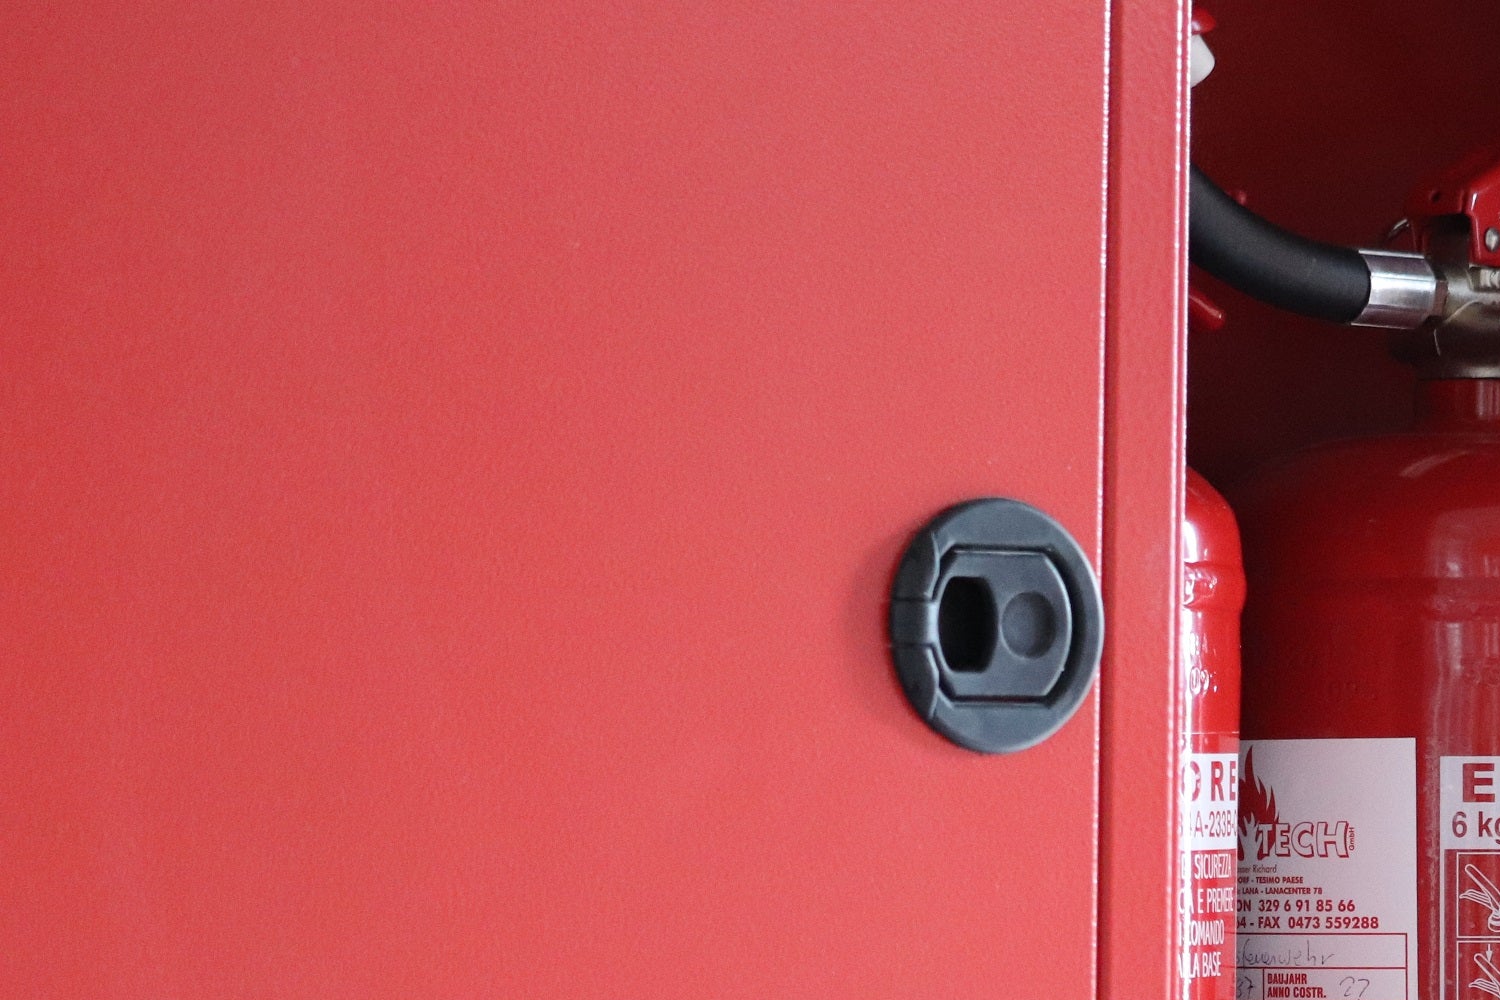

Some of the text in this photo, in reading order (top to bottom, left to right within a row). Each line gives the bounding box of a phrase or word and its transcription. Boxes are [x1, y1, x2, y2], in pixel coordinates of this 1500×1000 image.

[1452, 812, 1467, 837] 6
[1253, 865, 1277, 873] Richard
[1258, 900, 1355, 911] 329 6 91 85 66
[1258, 917, 1378, 928] FAX 0473 559288
[1203, 952, 1221, 977] BASE
[1268, 974, 1307, 984] BAUJAHR
[1268, 987, 1326, 998] ANNO COSTR.
